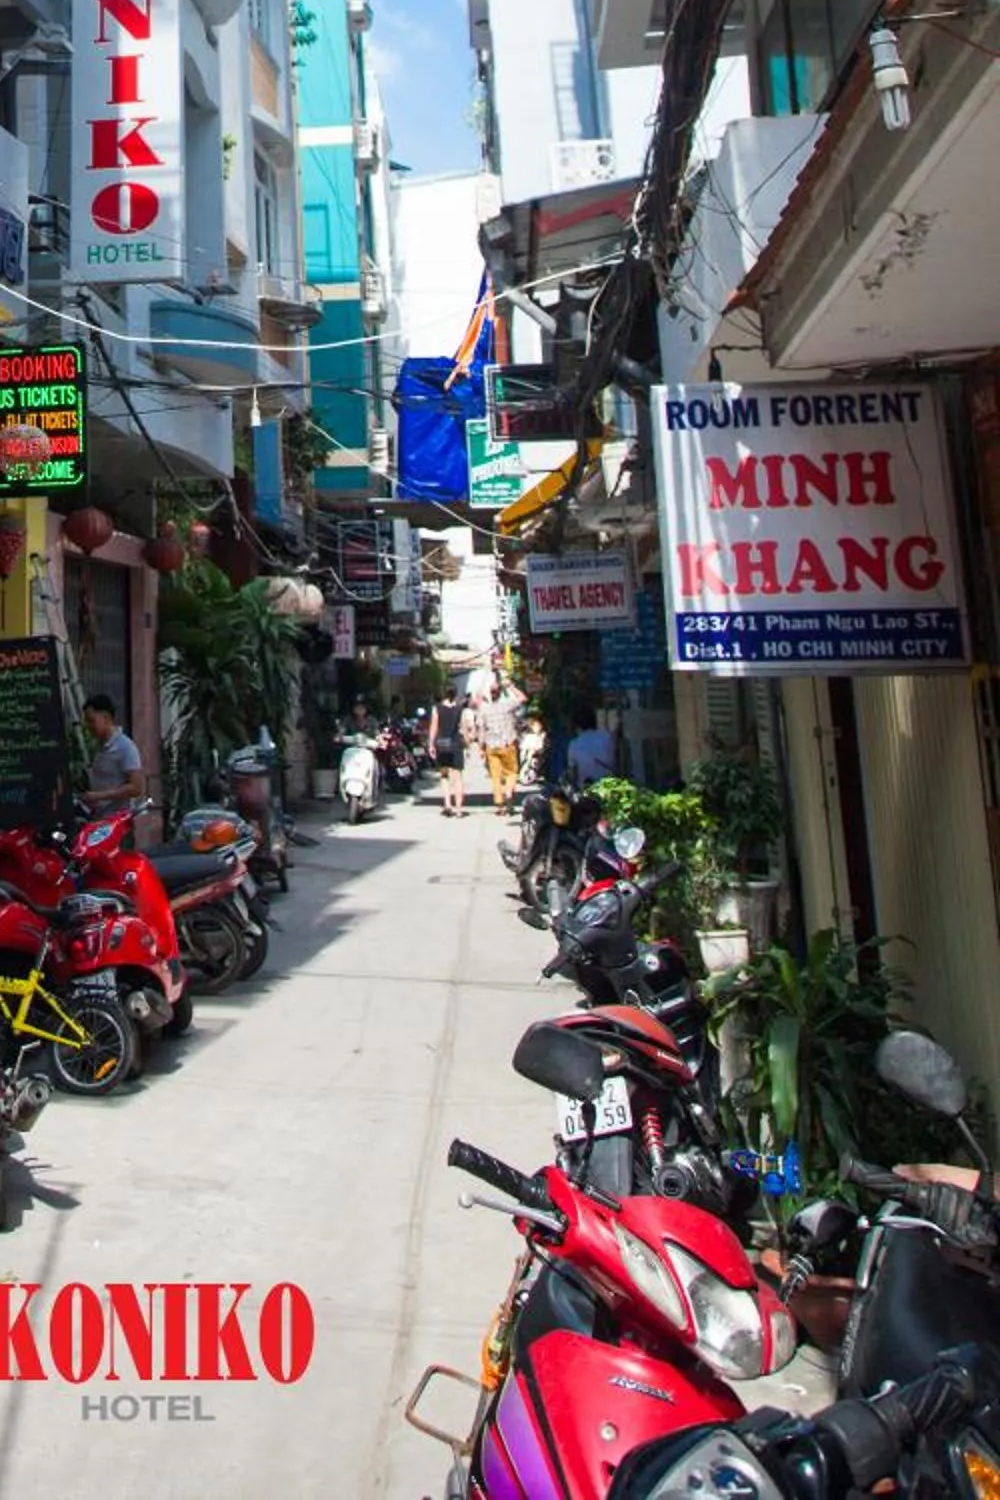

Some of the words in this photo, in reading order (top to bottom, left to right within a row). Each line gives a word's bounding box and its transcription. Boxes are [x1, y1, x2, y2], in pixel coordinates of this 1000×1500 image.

[87, 243, 163, 265] HOTEL
[0, 352, 75, 383] BOOKING
[18, 384, 77, 408] TICKETS
[40, 410, 77, 430] TICKETS
[665, 396, 761, 431] ROOM
[770, 391, 922, 427] FORRENT
[705, 451, 896, 510] MINH
[676, 535, 946, 597] KHANG
[533, 583, 577, 612] TRAVEL
[578, 581, 625, 610] AGENCY
[683, 615, 758, 634] 283/41
[765, 614, 820, 630] Pham
[825, 613, 866, 634] Ngu
[873, 612, 908, 630] Lao
[763, 642, 792, 658] HO
[797, 641, 833, 658] CHI
[840, 640, 894, 657] MINH
[902, 638, 949, 656] CITY
